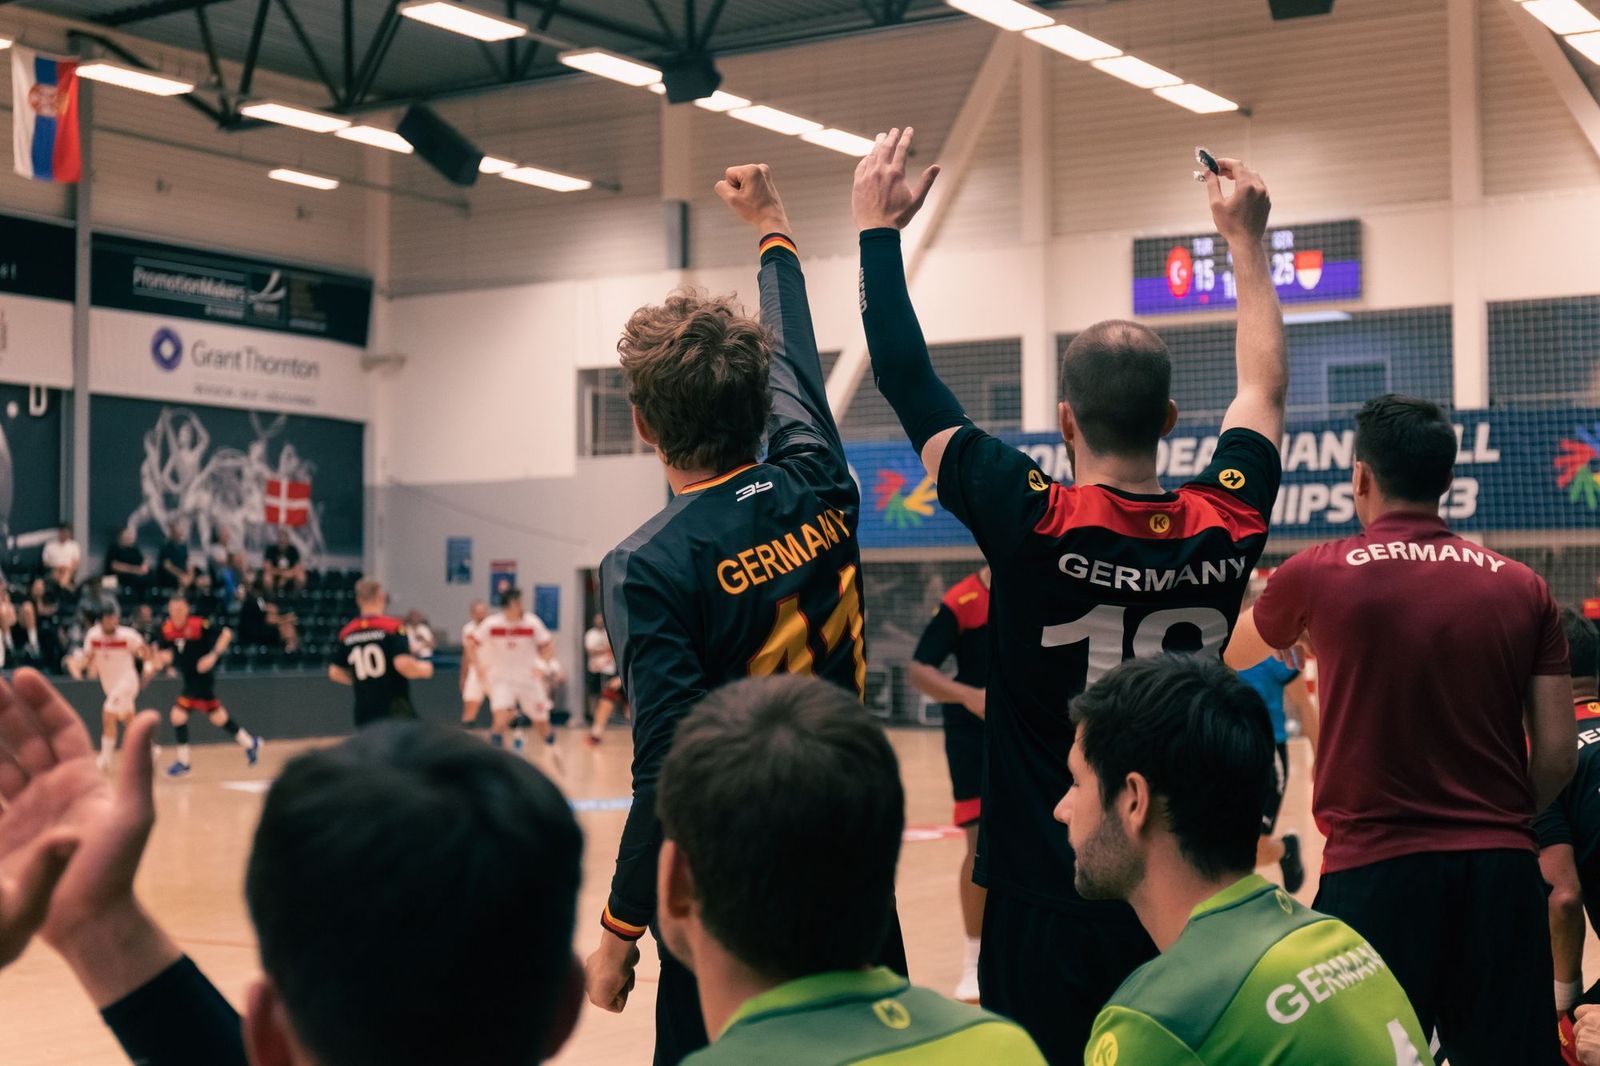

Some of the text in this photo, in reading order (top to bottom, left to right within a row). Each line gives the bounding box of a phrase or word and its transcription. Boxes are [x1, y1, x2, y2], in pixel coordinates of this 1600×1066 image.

[1194, 259, 1215, 292] 15
[1271, 252, 1295, 286] 25
[717, 509, 850, 595] GERMANY
[1346, 541, 1506, 573] GERMANY
[1058, 553, 1247, 592] GERMANY
[347, 643, 387, 680] 10
